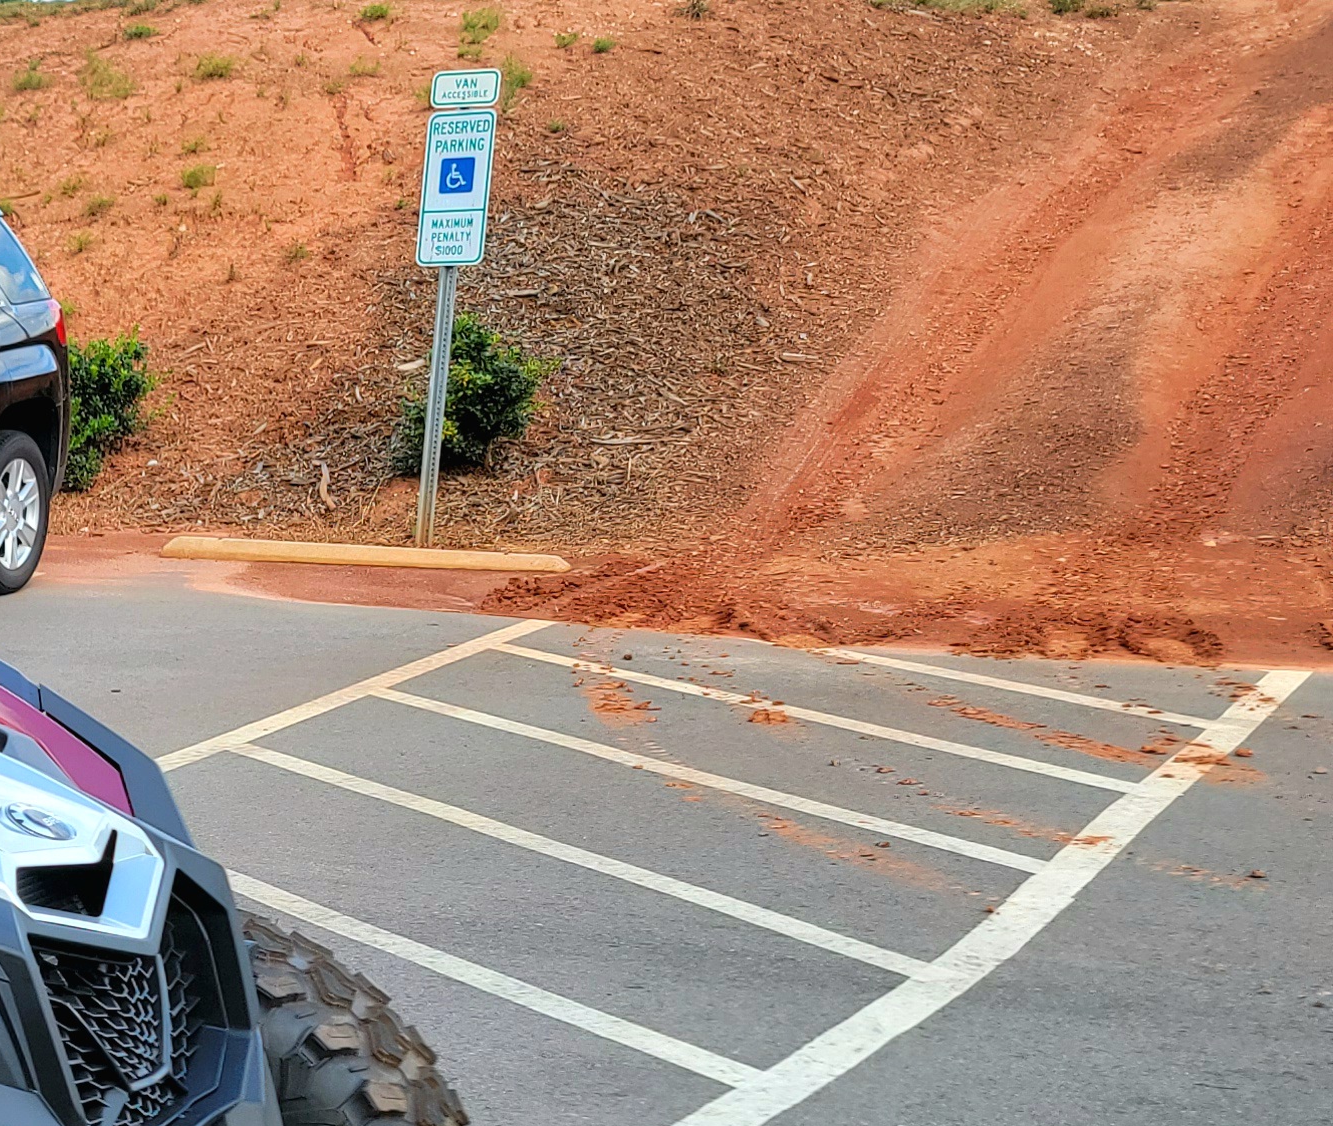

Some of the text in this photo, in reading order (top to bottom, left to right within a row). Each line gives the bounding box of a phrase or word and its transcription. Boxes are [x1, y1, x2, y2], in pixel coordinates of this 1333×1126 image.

[455, 78, 478, 89] VAN
[441, 89, 488, 99] ACCESSIBLE
[433, 119, 490, 135] RESERVED
[435, 138, 485, 153] PARKING
[431, 218, 474, 229] MAXIMUM
[431, 231, 471, 243] PENALTY
